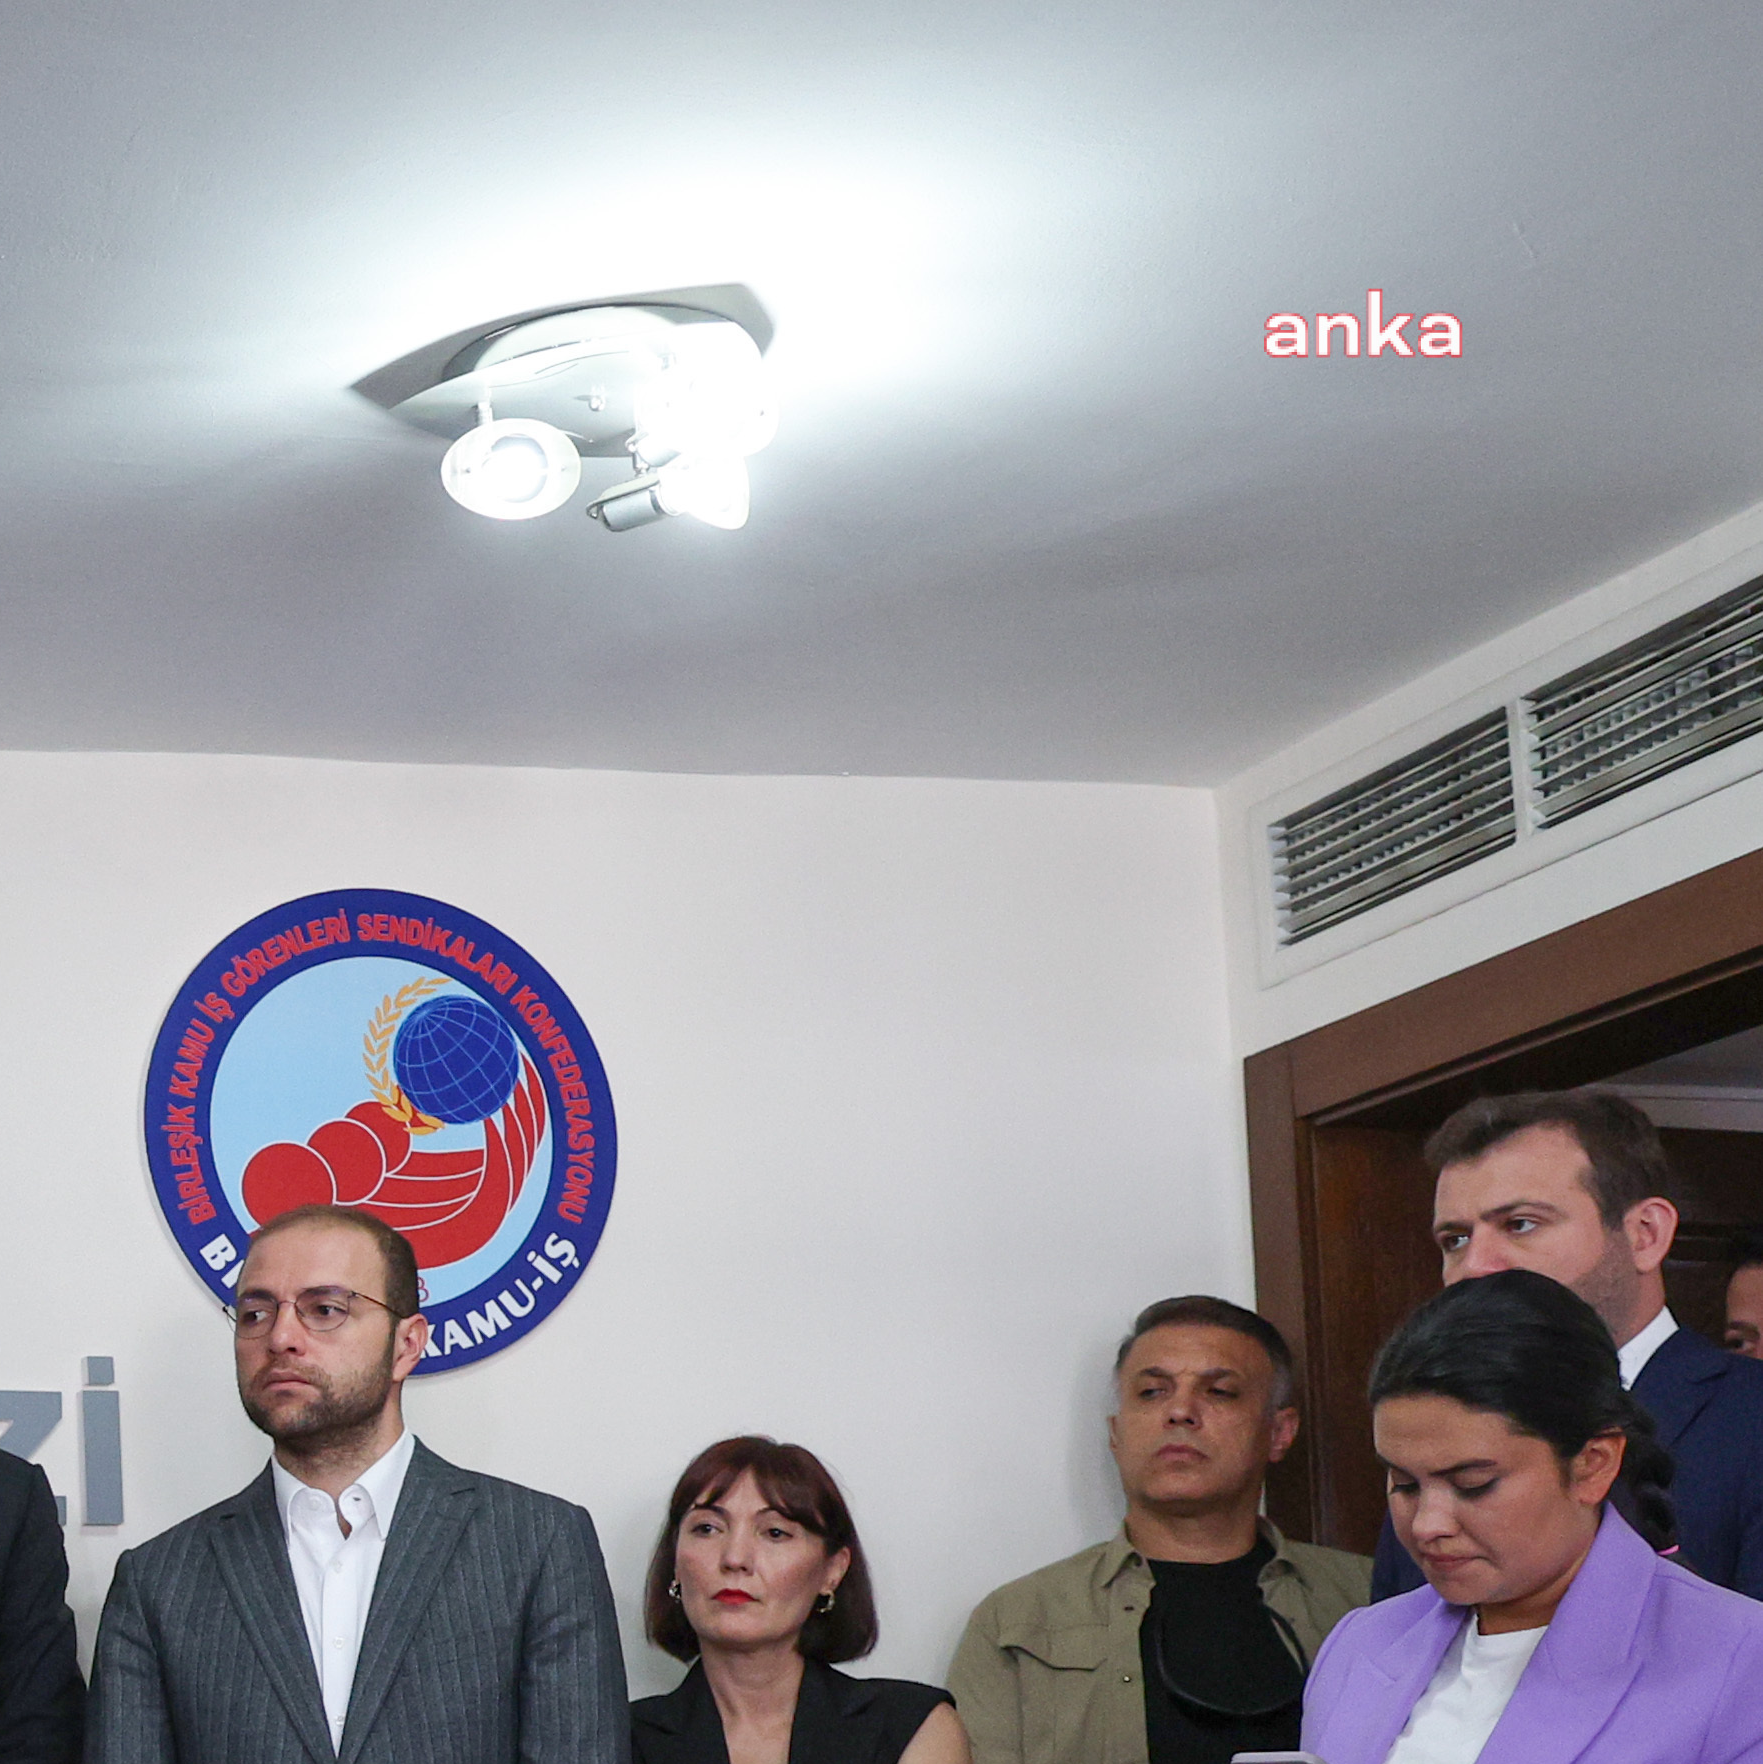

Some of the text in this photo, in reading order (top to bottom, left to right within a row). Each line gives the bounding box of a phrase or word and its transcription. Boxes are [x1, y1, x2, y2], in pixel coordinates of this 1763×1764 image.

[168, 1018, 216, 1099] KAMU
[220, 907, 351, 998] GÖRENLERİ
[357, 914, 519, 996] SENDİKALARI
[509, 984, 596, 1225] KONFEDERASYONU
